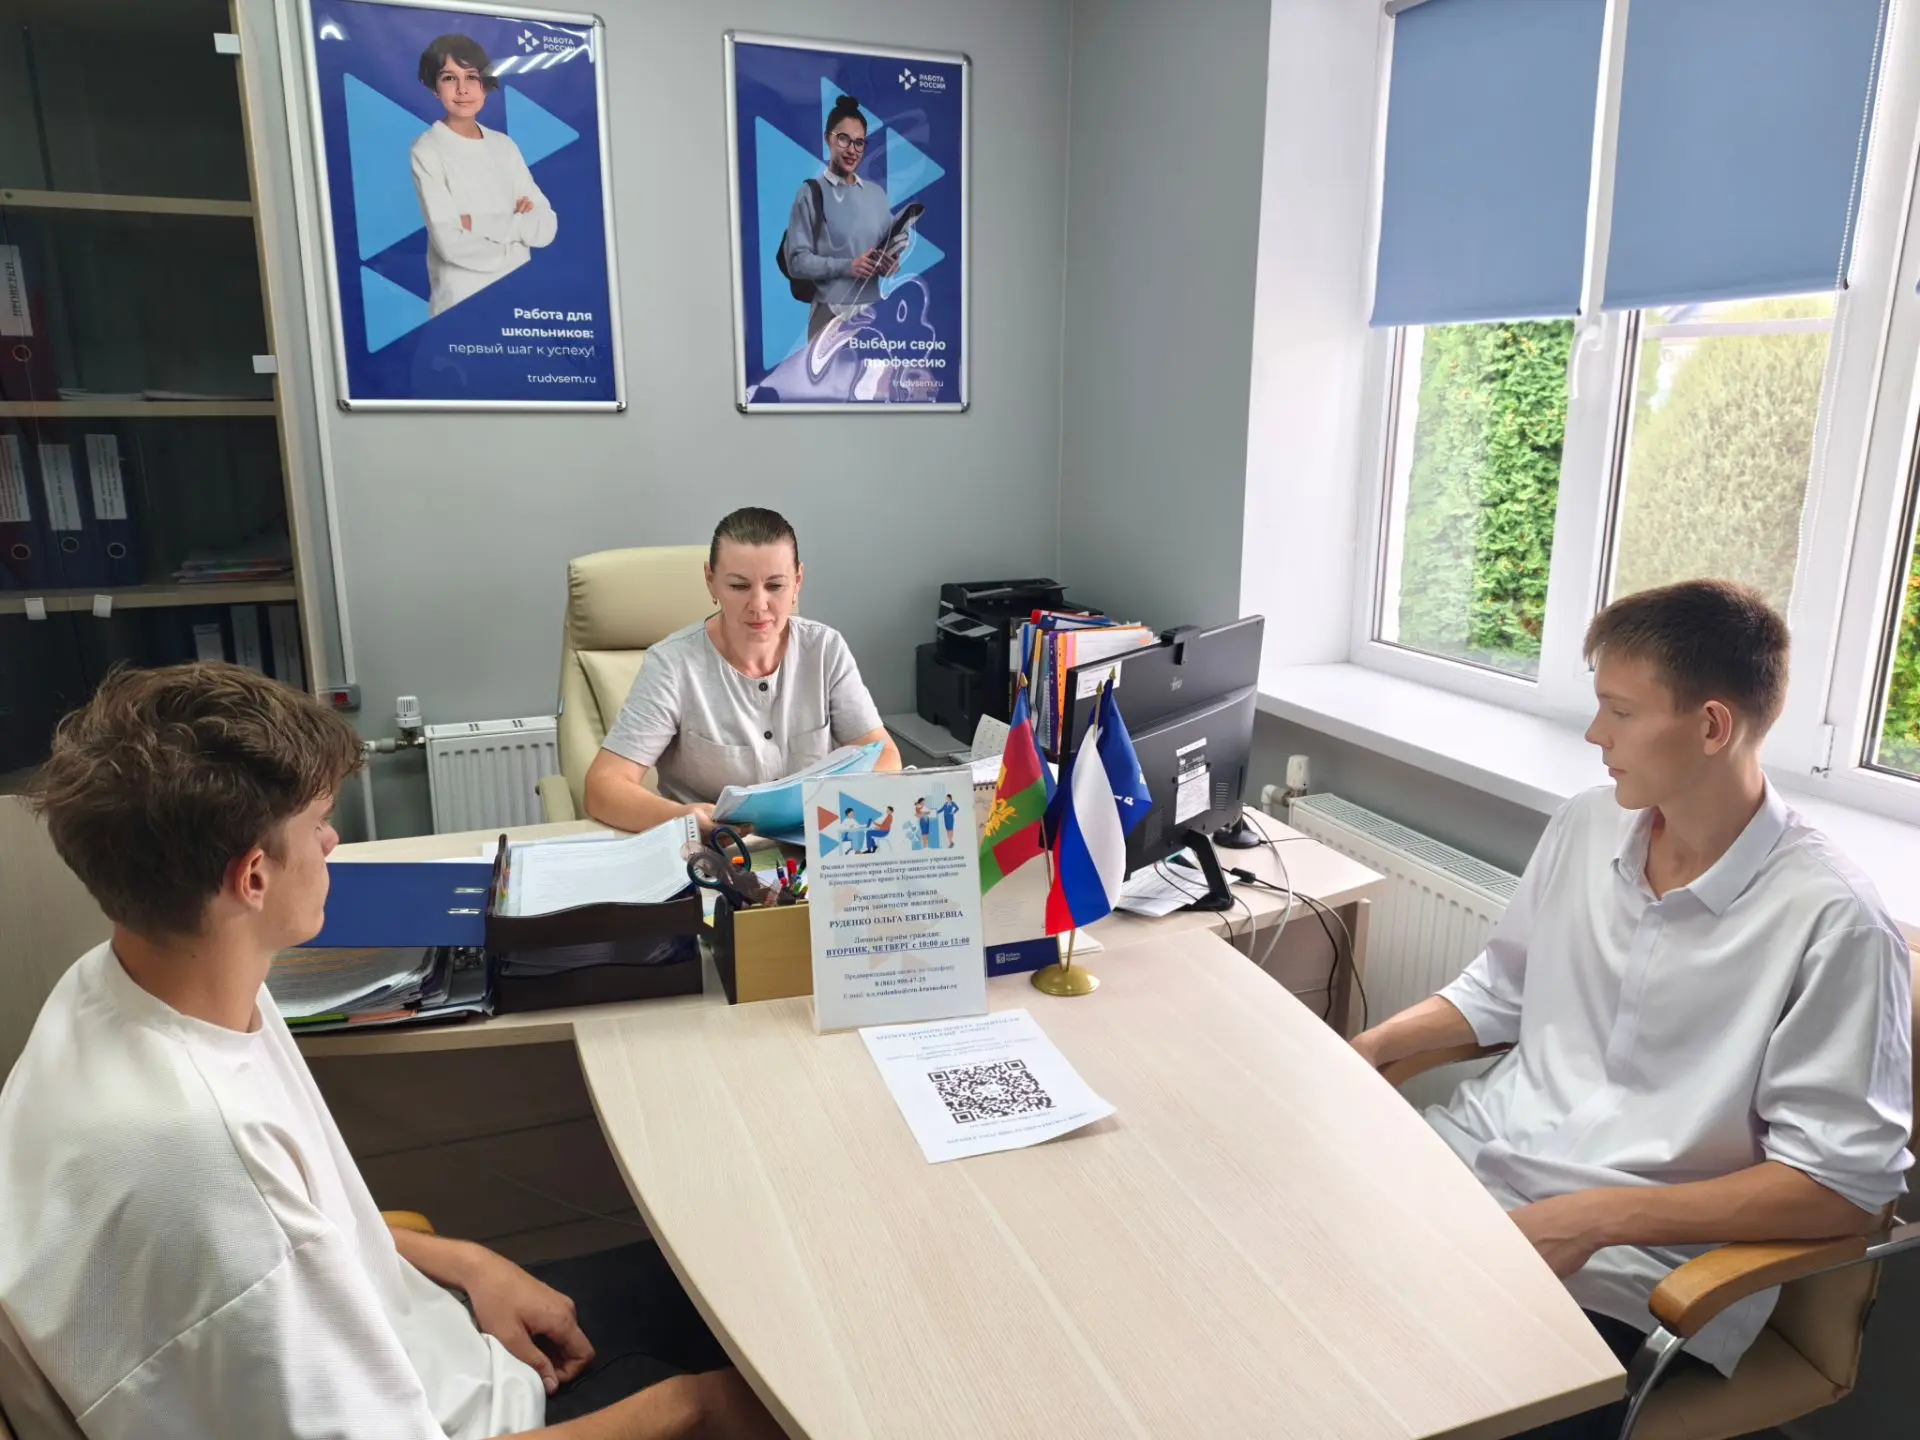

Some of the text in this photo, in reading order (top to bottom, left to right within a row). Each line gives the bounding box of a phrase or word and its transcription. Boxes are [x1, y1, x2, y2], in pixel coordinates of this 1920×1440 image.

[543, 36, 574, 45] РАБОТА
[919, 74, 945, 82] РАБОТА
[919, 81, 946, 89] РОССИИ
[513, 308, 593, 322] Работа для
[501, 327, 594, 338] школьников:
[849, 337, 946, 351] Выбери свою
[449, 343, 595, 358] первый шаг к успеху!
[864, 356, 946, 369] профессию
[527, 373, 596, 384] trudvsem.ru
[829, 910, 964, 928] РУДЕНКО ОЛЬГА ЕВГЕНЬЕВНА
[872, 942, 911, 953] ЧЕТВЕРГ
